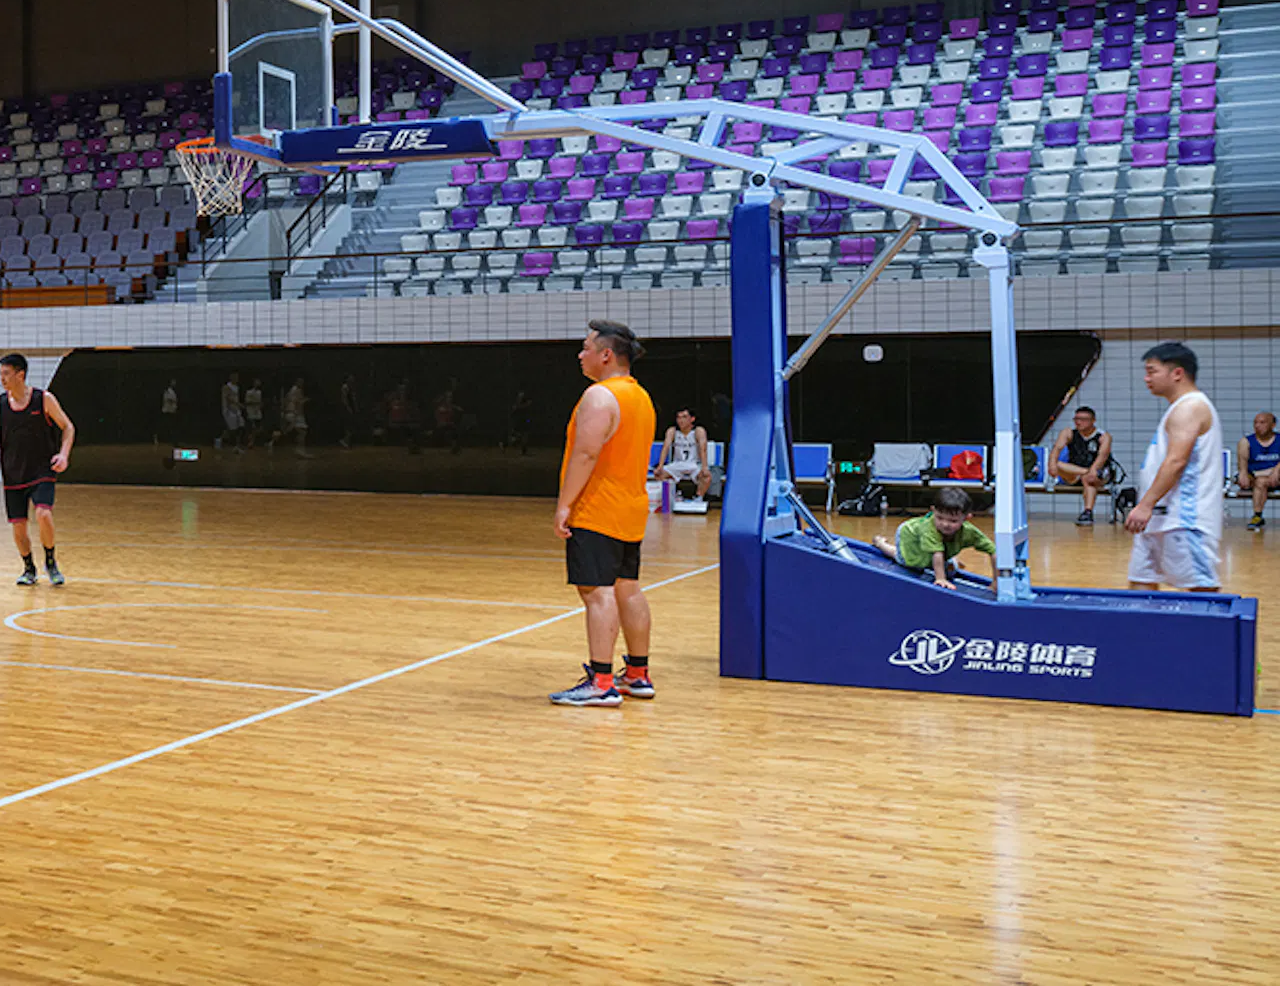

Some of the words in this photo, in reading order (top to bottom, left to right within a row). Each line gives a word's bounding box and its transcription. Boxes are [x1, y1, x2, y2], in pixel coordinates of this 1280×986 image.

[963, 638, 1097, 667] 金陵体育
[1028, 664, 1093, 678] SPORTS
